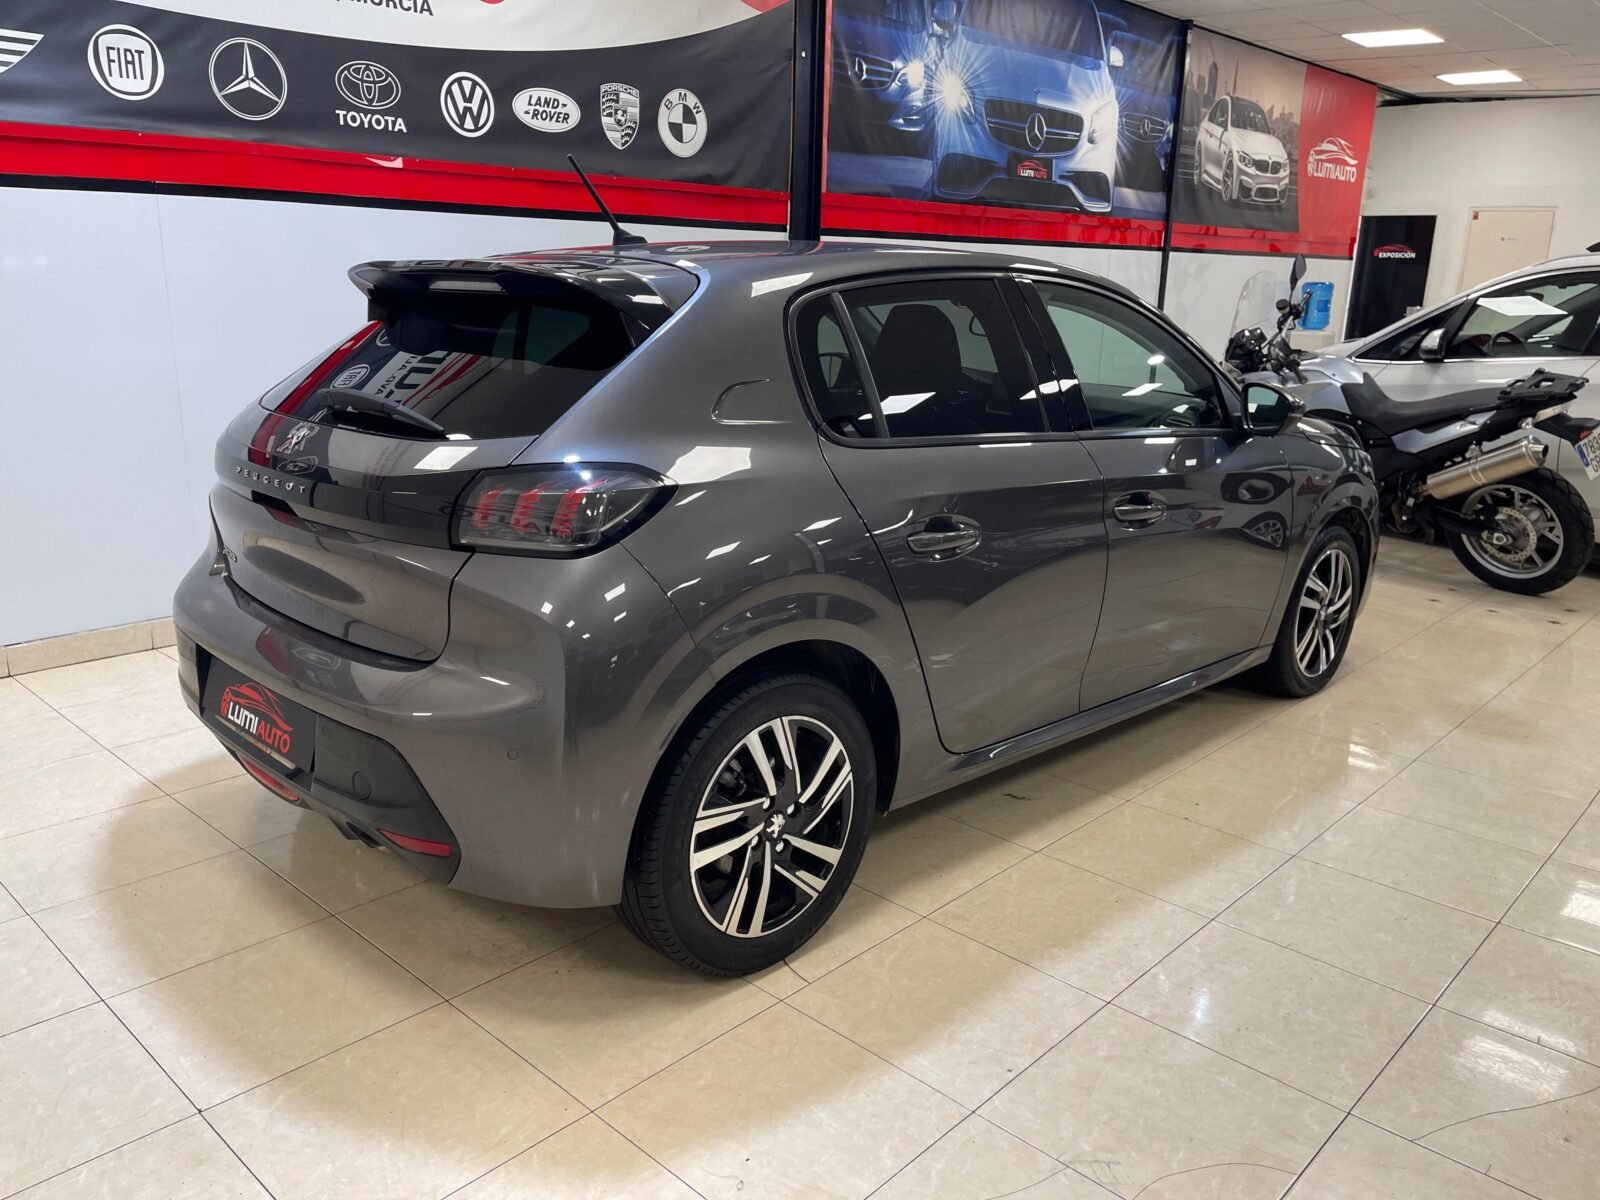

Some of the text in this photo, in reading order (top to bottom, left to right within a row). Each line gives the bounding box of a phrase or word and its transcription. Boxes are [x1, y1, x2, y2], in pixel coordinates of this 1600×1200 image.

[105, 46, 145, 81] FIAT
[601, 84, 639, 99] PORSCHE
[335, 109, 408, 133] TOYOTA
[235, 466, 305, 494] PEUGEOT
[227, 700, 291, 754] LUMIAUTO
